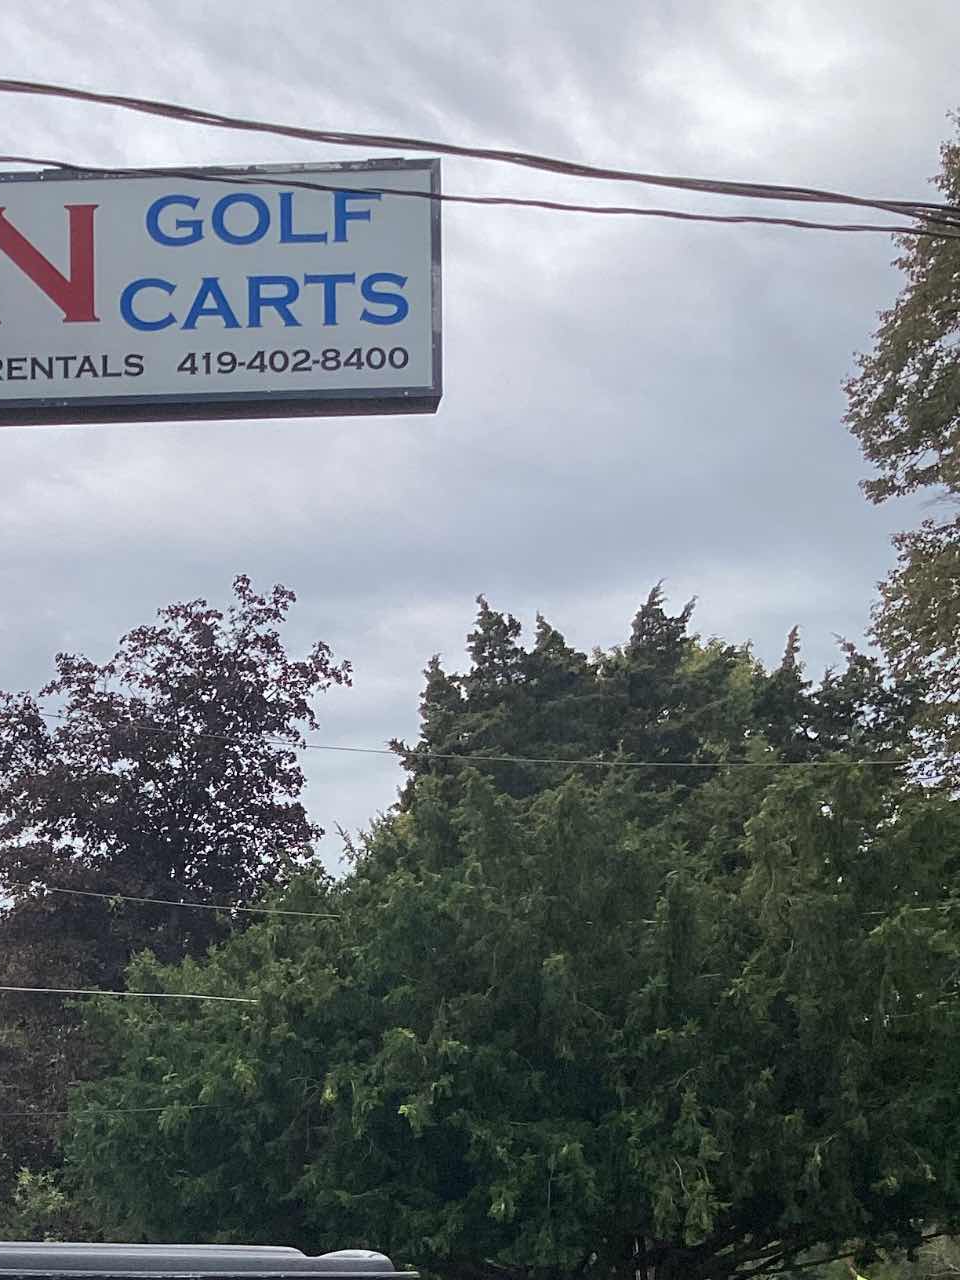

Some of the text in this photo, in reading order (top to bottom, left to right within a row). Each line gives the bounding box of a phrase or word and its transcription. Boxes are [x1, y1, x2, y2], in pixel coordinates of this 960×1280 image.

[146, 189, 382, 247] GOLF
[119, 272, 410, 332] CARTS
[177, 346, 410, 376] 419-402-8400
